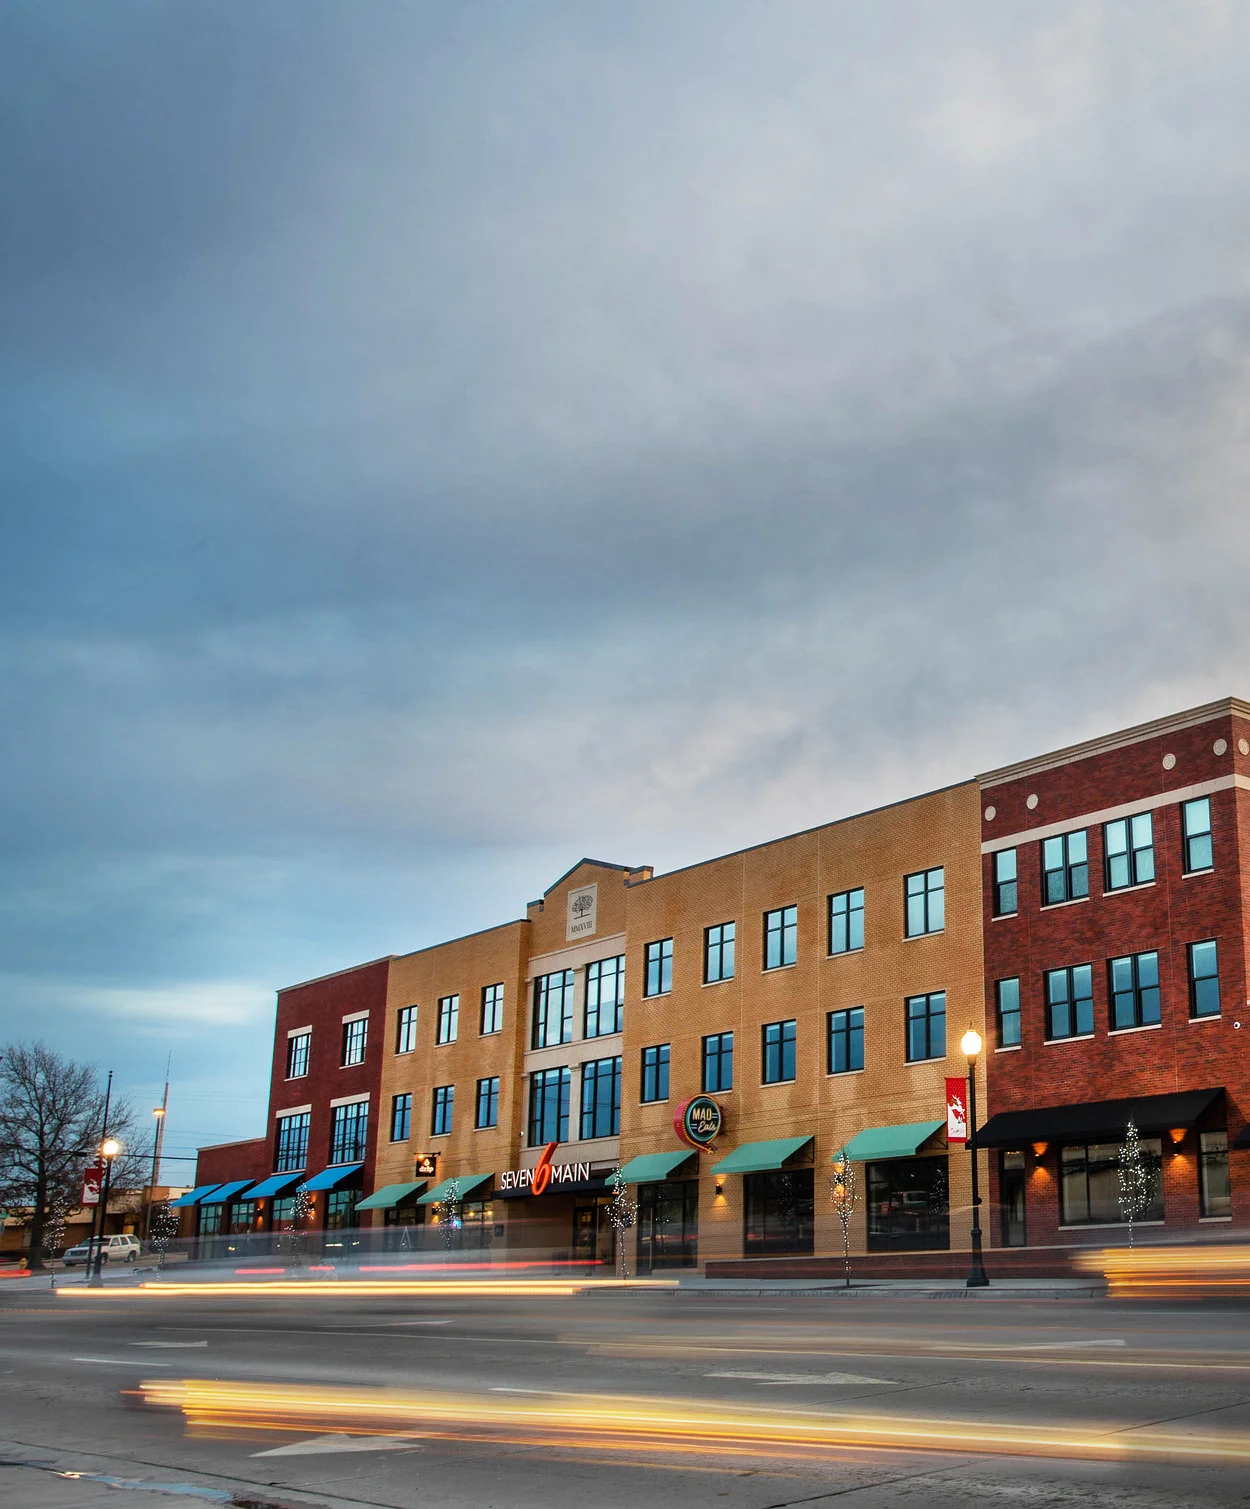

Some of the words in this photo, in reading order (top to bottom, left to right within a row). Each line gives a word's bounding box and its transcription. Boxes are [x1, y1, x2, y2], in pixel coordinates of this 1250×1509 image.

[692, 1108, 712, 1121] MAD
[500, 1168, 535, 1190] SEVEN
[531, 1142, 559, 1196] 6
[551, 1162, 590, 1184] MAIN
